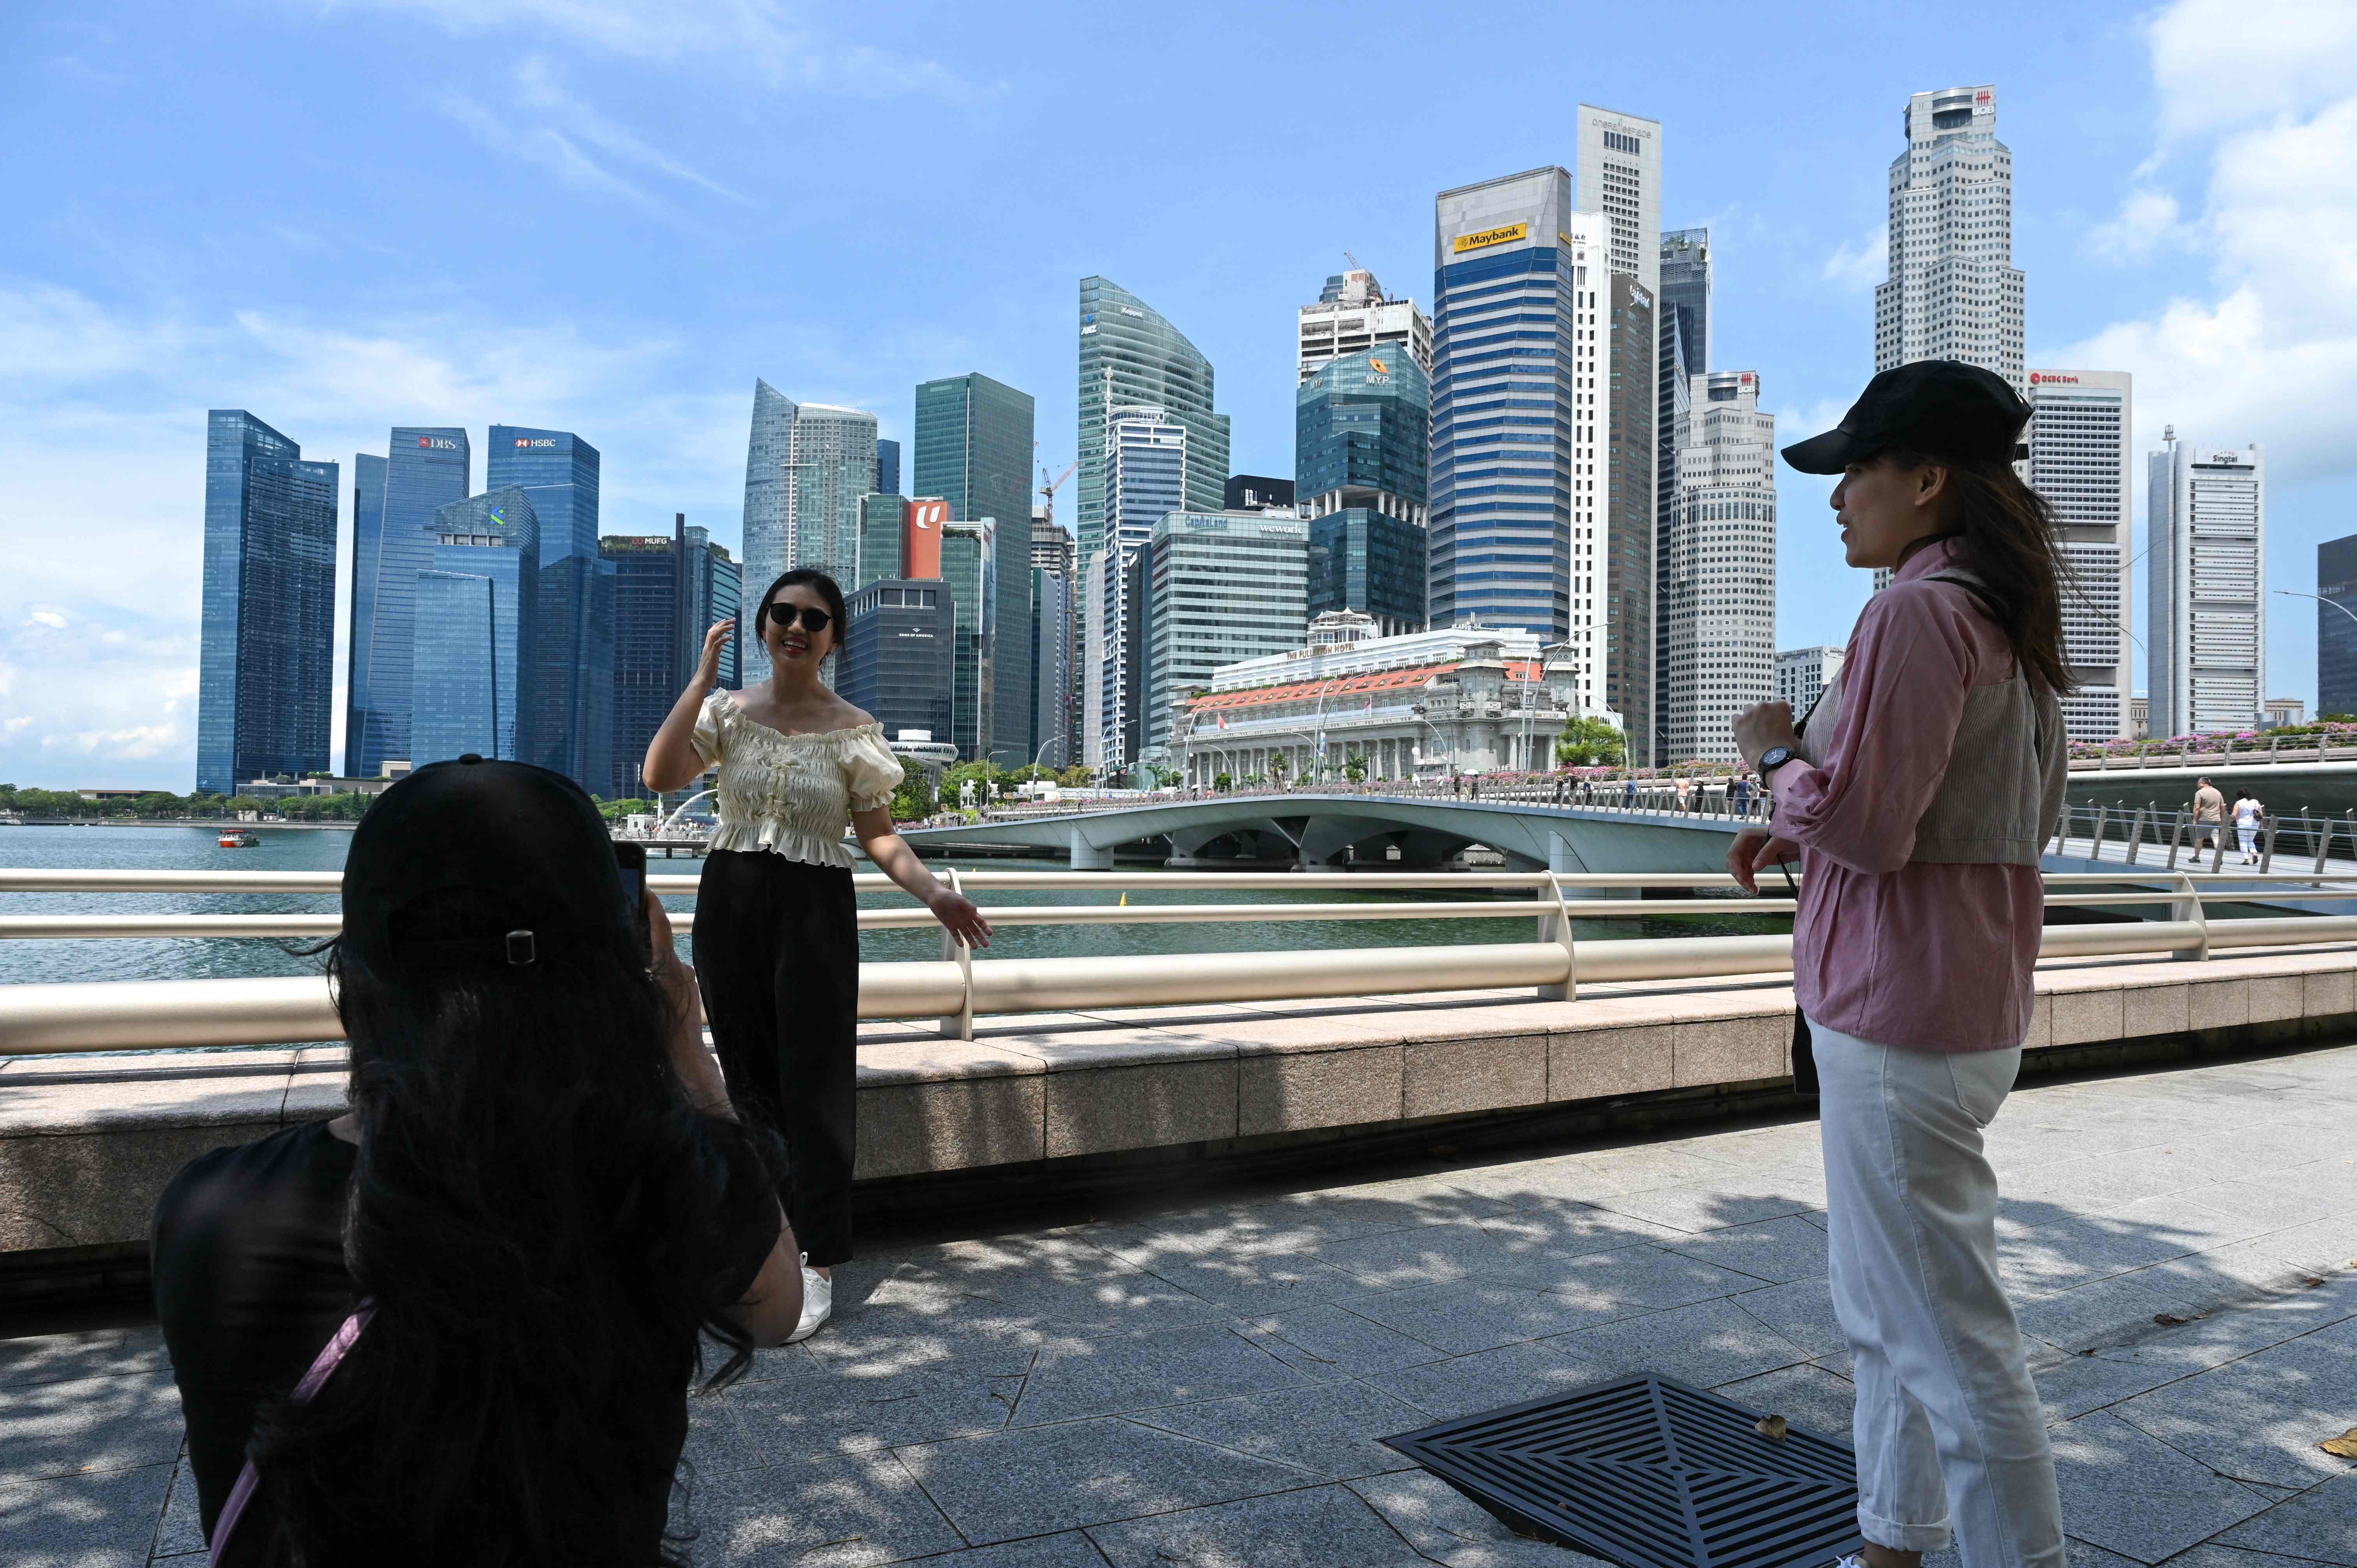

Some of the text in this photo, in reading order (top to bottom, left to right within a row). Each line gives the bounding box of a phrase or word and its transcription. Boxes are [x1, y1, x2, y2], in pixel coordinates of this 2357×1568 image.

[1972, 106, 1994, 115] UOB
[1469, 227, 1519, 245] Maybank
[1122, 305, 1143, 318] Keppel
[1081, 325, 1097, 335] ANZ
[1310, 377, 1322, 390] MYP
[1366, 375, 1389, 384] MYP
[2063, 376, 2079, 384] Bank
[431, 438, 456, 449] DBS
[2213, 454, 2238, 464] Singtel
[1185, 514, 1228, 529] CapitaLand
[1259, 523, 1302, 533] wework
[1287, 643, 1355, 660] THE FULLERTON HOTEL
